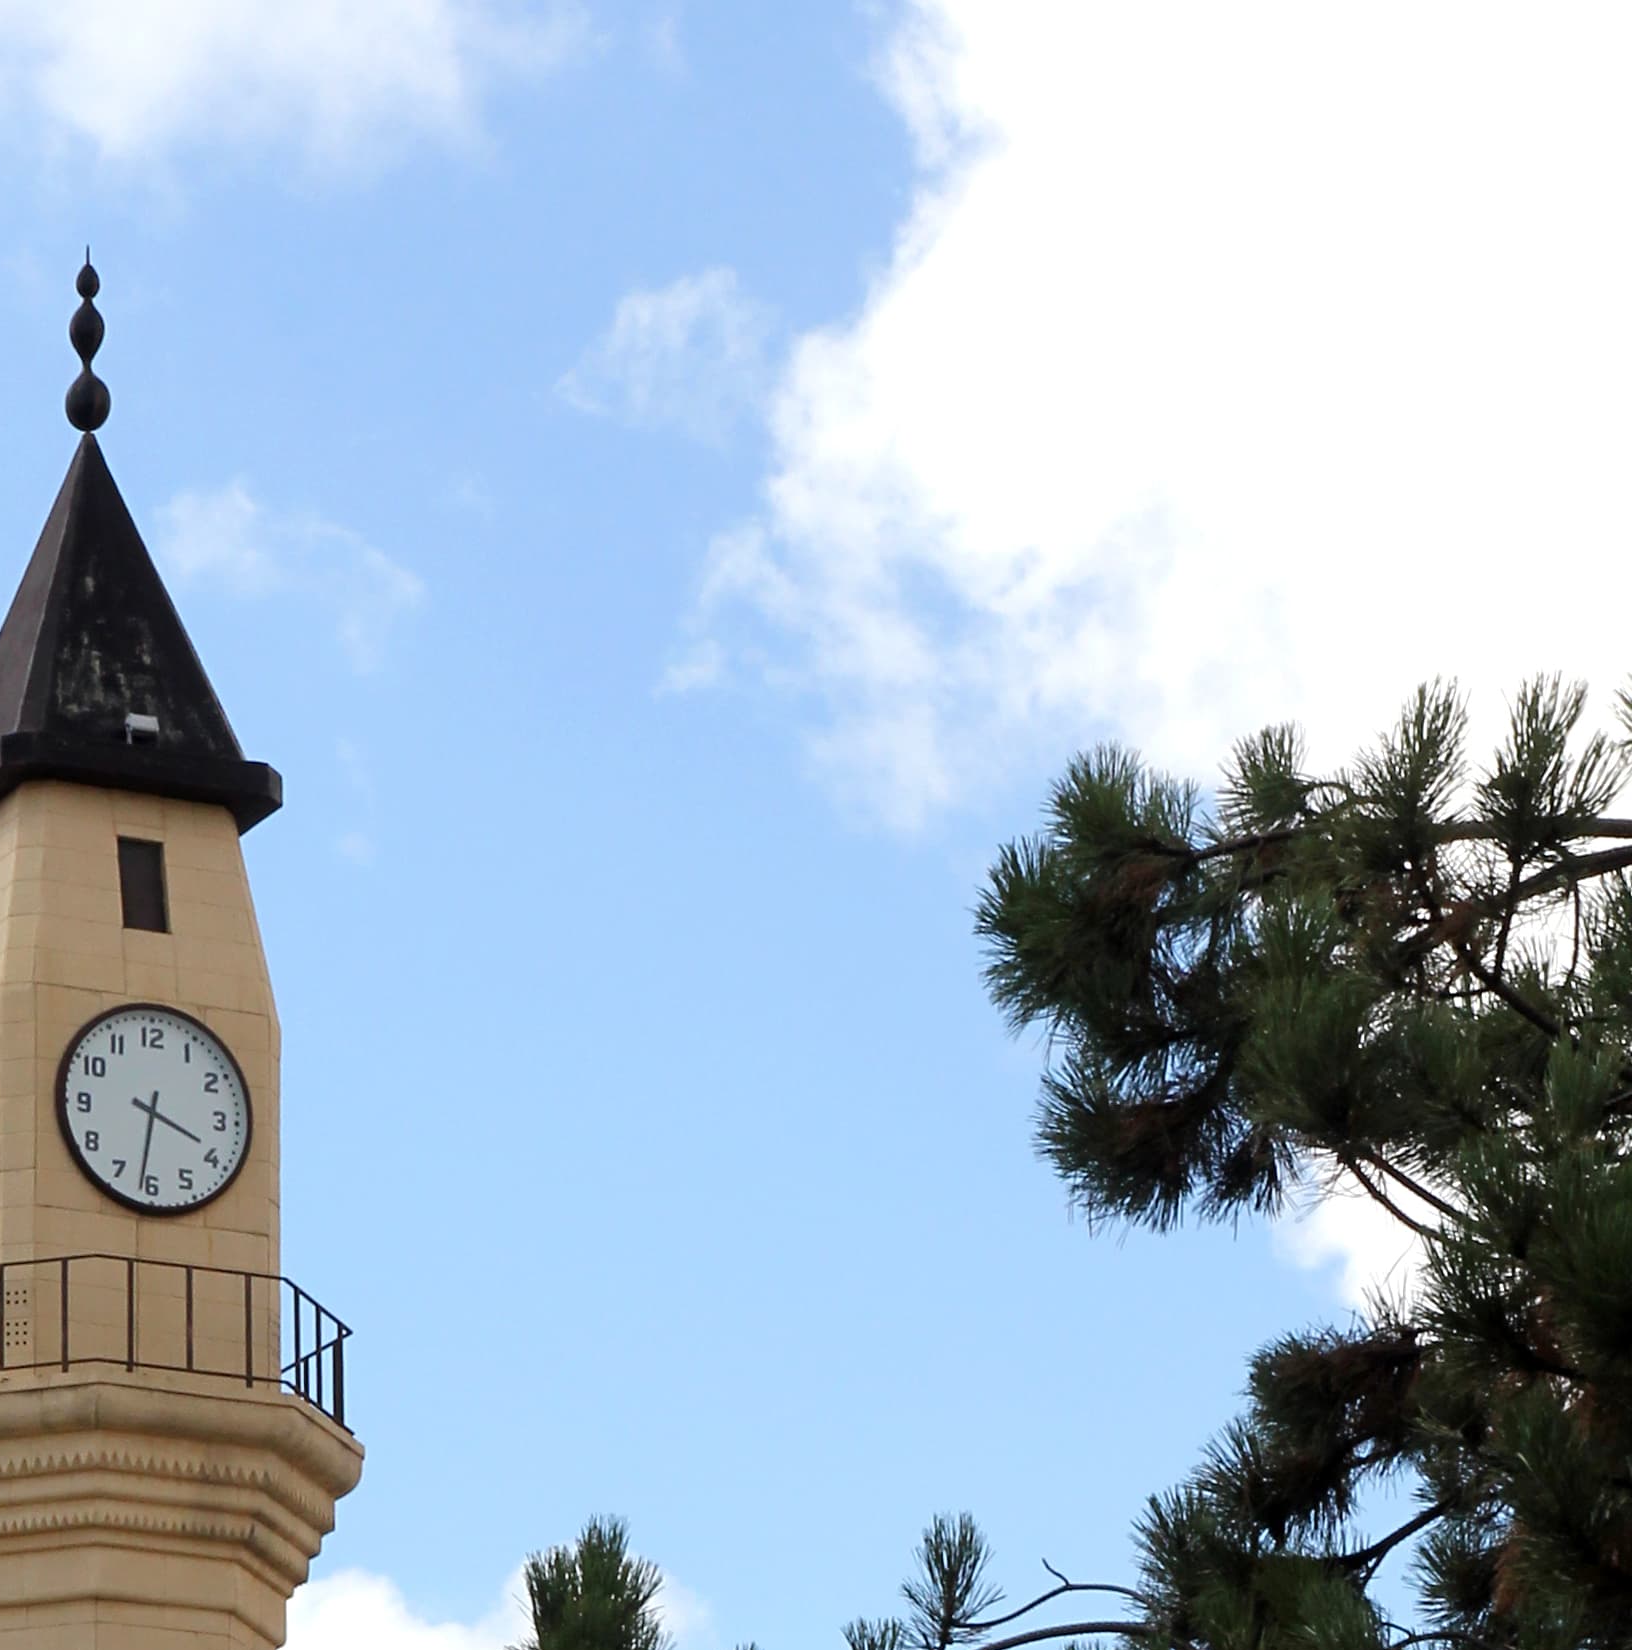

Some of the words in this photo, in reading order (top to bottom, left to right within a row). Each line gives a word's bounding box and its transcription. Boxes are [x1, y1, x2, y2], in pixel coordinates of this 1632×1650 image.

[110, 1034, 124, 1055] 11
[141, 1027, 164, 1049] 12
[183, 1043, 191, 1063] 1
[83, 1056, 106, 1077] 10
[204, 1073, 219, 1093] 2
[77, 1093, 92, 1113] 9
[212, 1112, 226, 1132] 3
[85, 1131, 99, 1151] 8
[204, 1148, 219, 1168] 4
[112, 1160, 127, 1178] 7
[145, 1176, 159, 1196] 6
[179, 1170, 192, 1191] 5
